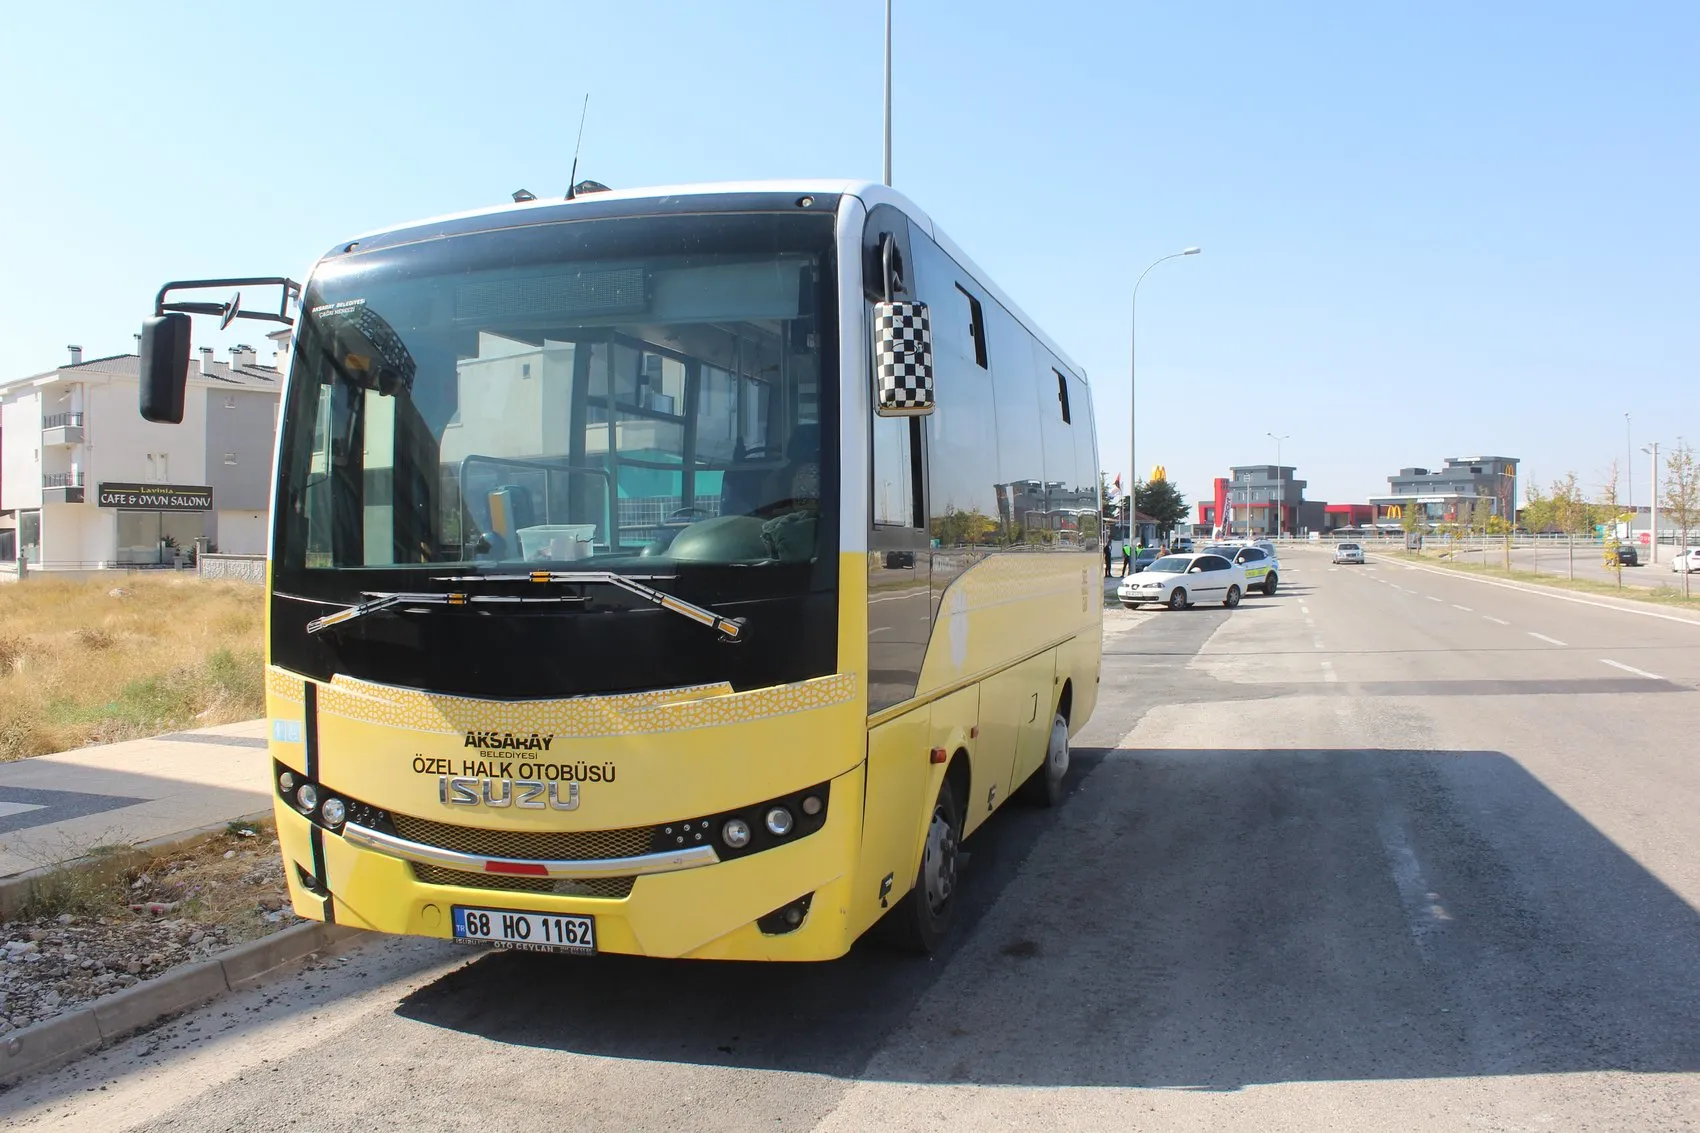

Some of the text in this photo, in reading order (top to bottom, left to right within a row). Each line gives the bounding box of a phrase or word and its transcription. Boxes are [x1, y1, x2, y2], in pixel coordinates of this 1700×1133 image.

[140, 486, 174, 494] Lavinia
[101, 493, 211, 507] CAFE & OYUN SALONU
[479, 750, 538, 760] BELEDİYESİ
[412, 753, 616, 783] ÖZEL HALK OTOBÜSÜ
[438, 775, 580, 811] ISUZU
[456, 924, 466, 932] TR
[466, 911, 592, 945] 68 HO 1162
[493, 940, 513, 950] OTO
[516, 942, 554, 953] CEYLAN
